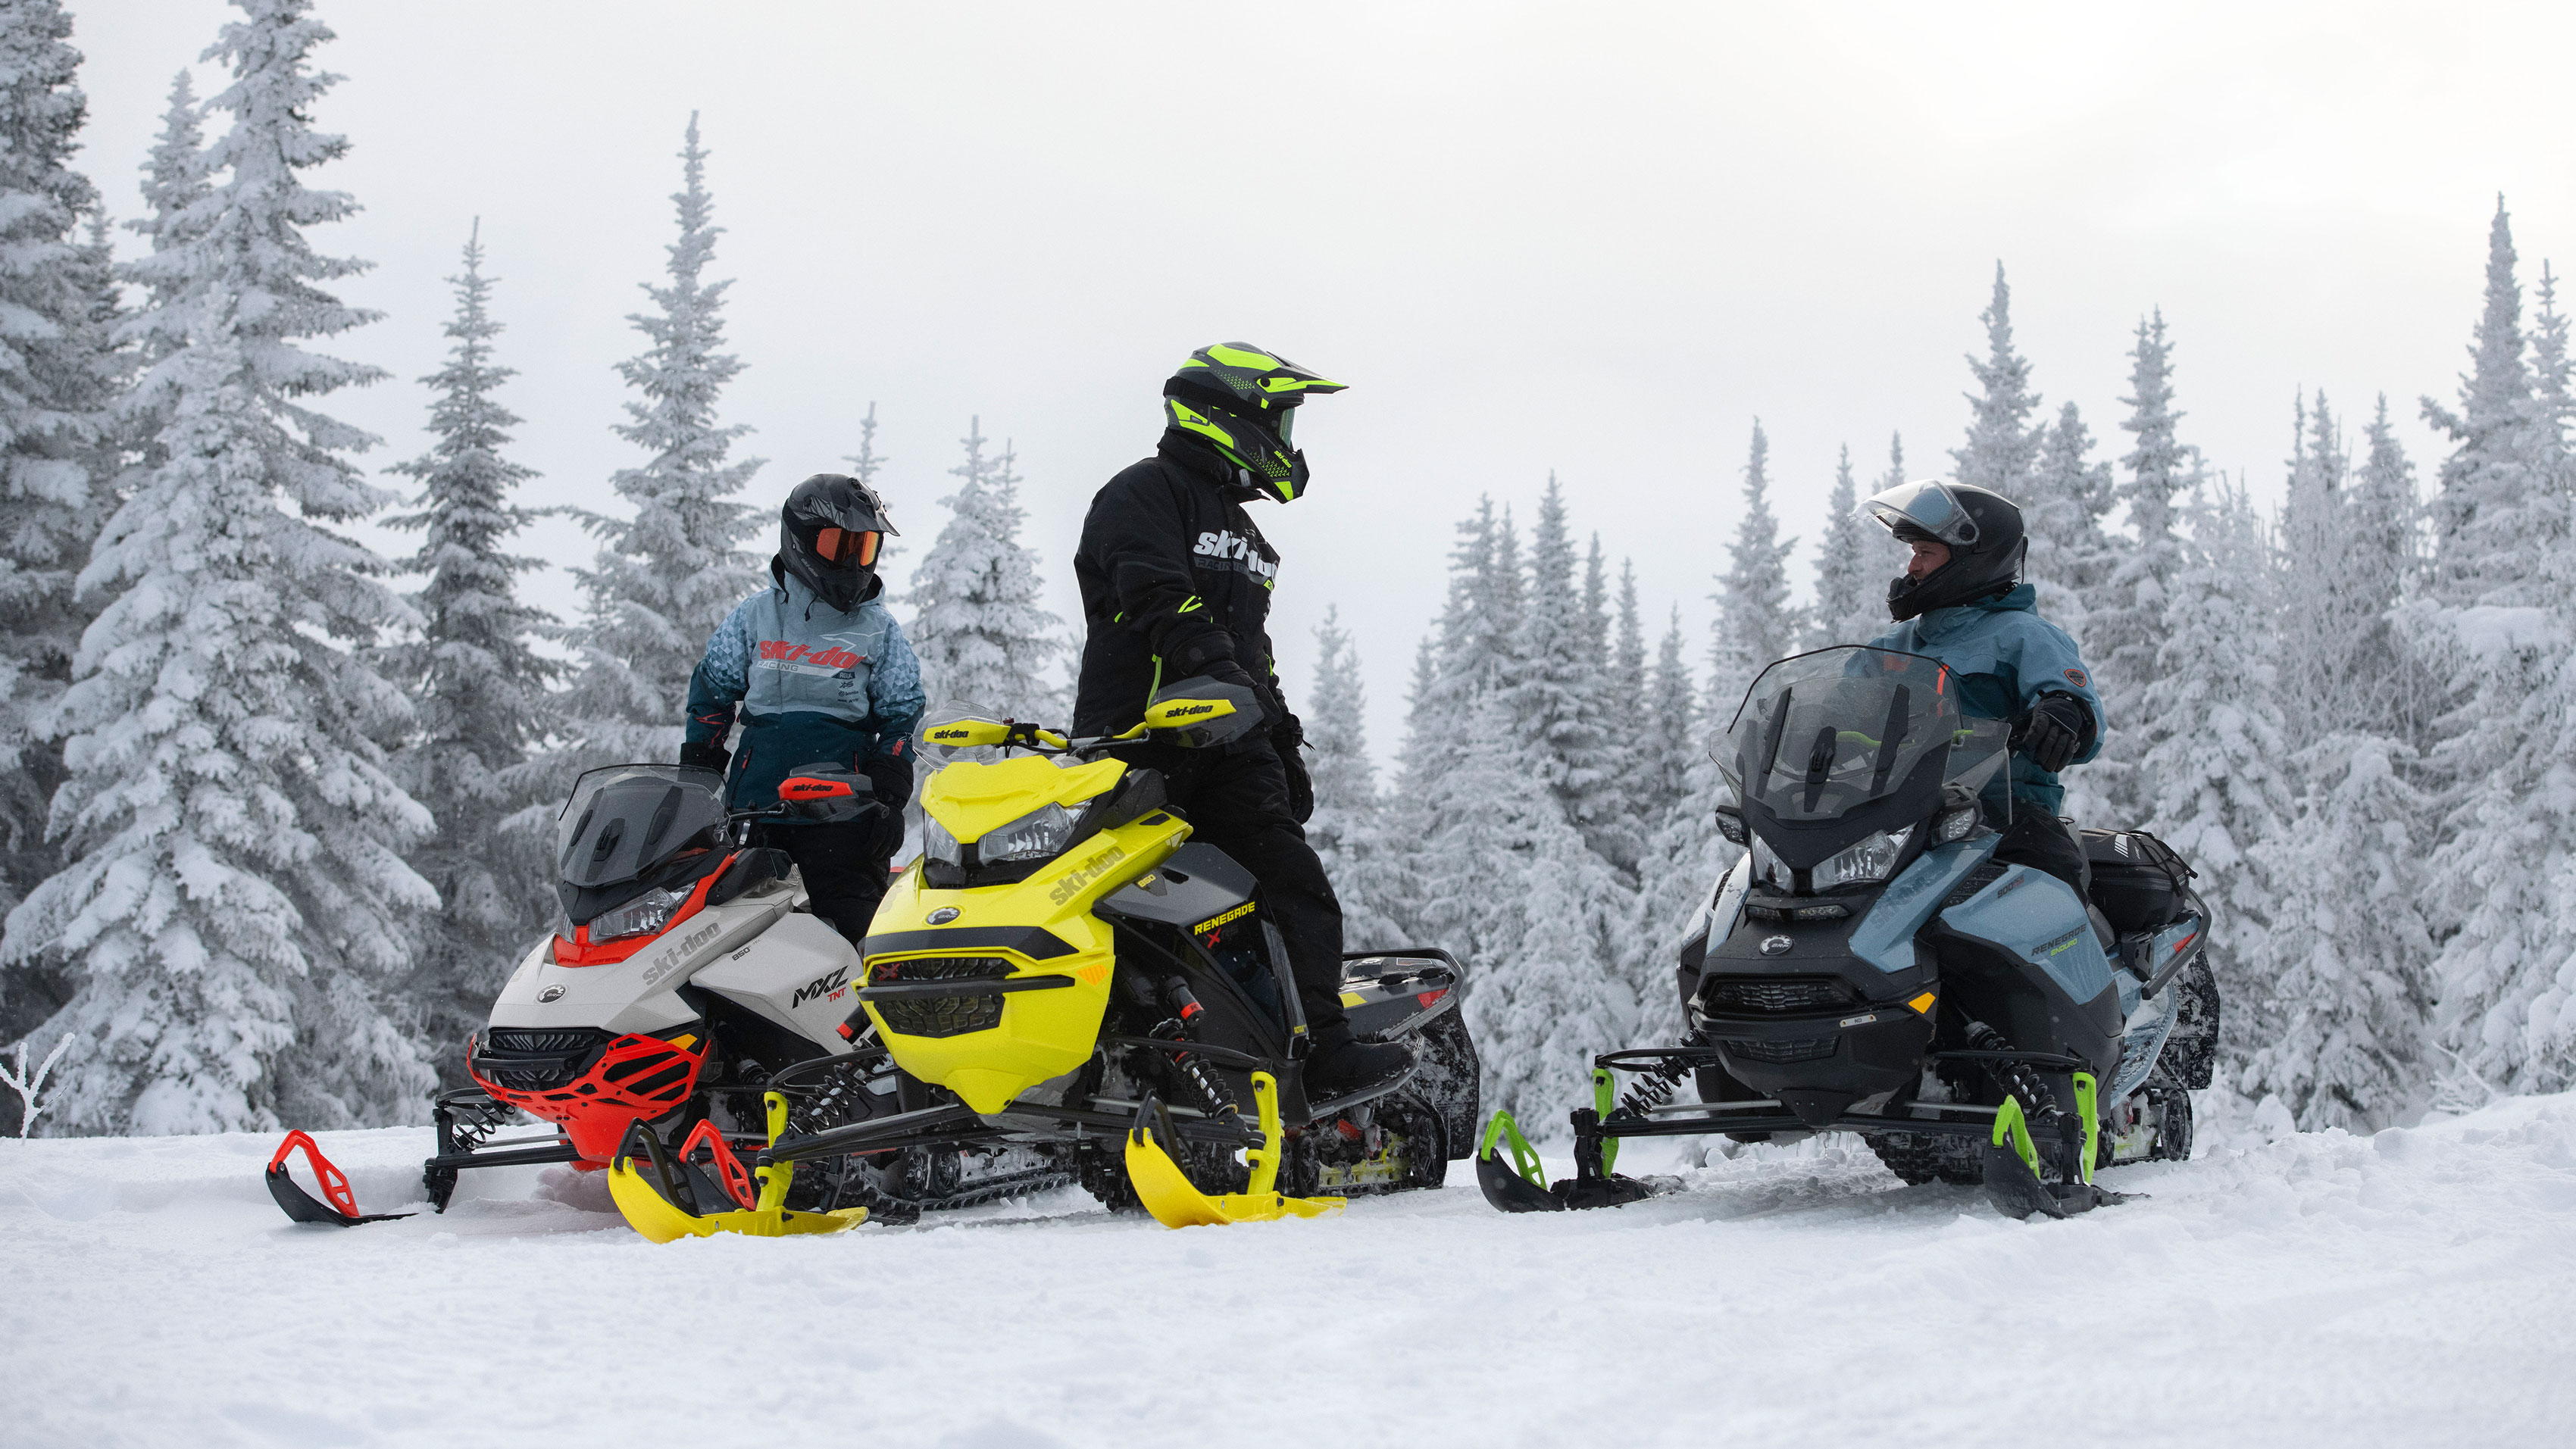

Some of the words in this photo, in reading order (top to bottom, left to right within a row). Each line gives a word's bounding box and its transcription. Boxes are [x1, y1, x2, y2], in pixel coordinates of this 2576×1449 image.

[757, 660, 799, 672] RACING
[1165, 705, 1214, 718] ski-doo
[934, 729, 969, 739] ski-doo
[792, 783, 833, 792] ski-doo
[1049, 846, 1126, 906] ski-doo
[1137, 874, 1156, 888] 850
[1997, 882, 2013, 898] 900
[1194, 901, 1255, 936] RENEGADE
[2031, 923, 2087, 956] RENEGADE
[2050, 938, 2077, 957] ENDURO
[642, 922, 721, 985] ski-doo
[732, 947, 751, 961] 850
[792, 965, 849, 1009] MXZ
[827, 987, 846, 1003] TNT
